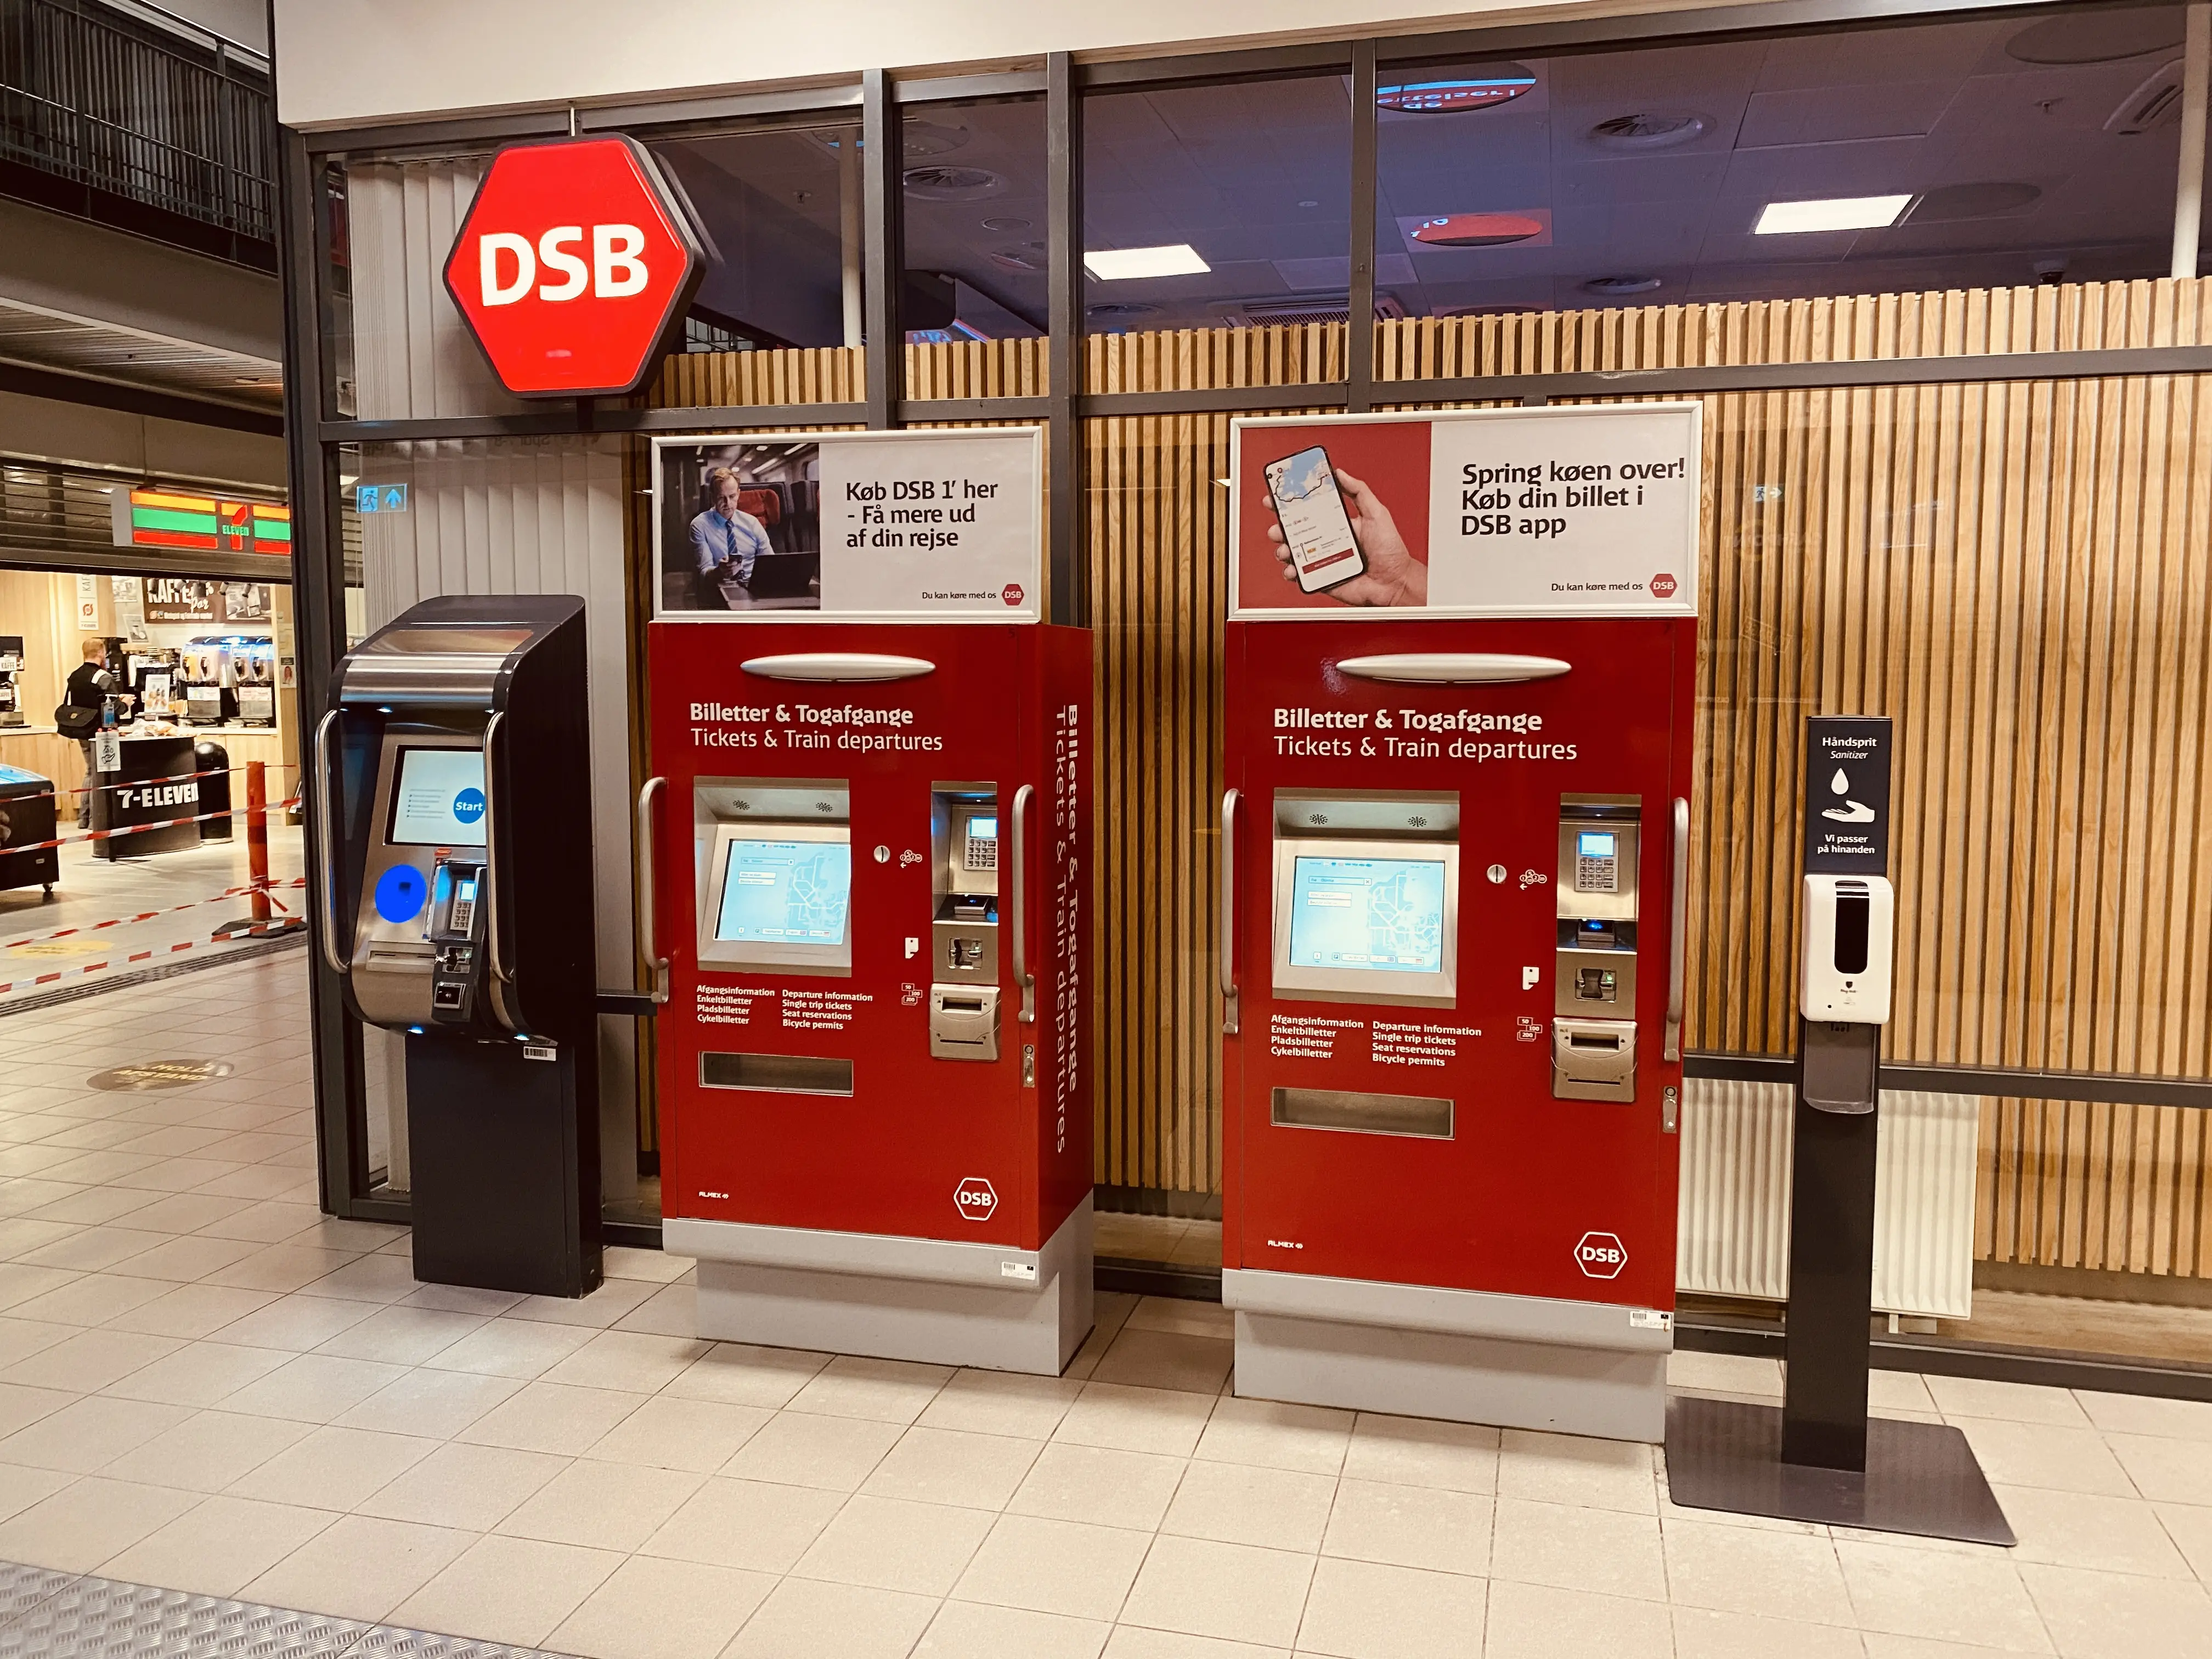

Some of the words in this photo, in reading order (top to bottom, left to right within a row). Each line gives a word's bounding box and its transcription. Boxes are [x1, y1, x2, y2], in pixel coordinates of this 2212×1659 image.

[479, 224, 648, 307] DSB
[1463, 463, 1542, 487] Spring
[1550, 461, 1611, 481] køen
[1620, 458, 1684, 479] over!
[847, 482, 886, 501] Køb
[894, 481, 934, 500] DSB
[964, 479, 998, 498] her
[1463, 488, 1510, 510] Køb
[1519, 488, 1556, 508] din
[1566, 486, 1628, 507] billet
[1638, 485, 1643, 505] i
[863, 504, 884, 524] Få
[891, 509, 943, 523] mere
[950, 503, 975, 522] ud
[1462, 515, 1511, 535] DSB
[1519, 518, 1566, 539] app
[847, 528, 867, 547] af
[872, 528, 902, 547] din
[910, 528, 958, 551] rejse
[82, 574, 92, 591] KAF
[691, 703, 770, 721] Billetter
[776, 704, 791, 722] &
[795, 705, 913, 727] Togafgange
[1274, 708, 1368, 728] Billetter
[1375, 709, 1392, 729] &
[1399, 709, 1542, 734] Togafgange
[691, 729, 757, 747] Tickets
[764, 730, 777, 747] &
[784, 730, 830, 748] Train
[838, 730, 942, 753] departures
[1822, 736, 1877, 748] Håndsprit
[1274, 736, 1351, 755] Tickets
[1360, 737, 1375, 756] &
[1384, 737, 1439, 757] Train
[1449, 738, 1577, 763] departures
[1830, 751, 1868, 759] Sanitizer
[1056, 704, 1066, 827] Tickets
[1069, 704, 1077, 845] Billetter
[455, 802, 483, 811] Start
[1057, 840, 1066, 864] &
[1817, 845, 1829, 854] på
[1831, 845, 1875, 854] hinanden
[1069, 856, 1077, 883] &
[1057, 874, 1066, 958] Train
[697, 984, 775, 997] Afgangsinformation
[782, 990, 823, 1000] Departure
[825, 991, 873, 1001] information
[1068, 889, 1078, 1092] Togafgange
[697, 995, 753, 1005] Enkeltbilletter
[782, 1000, 807, 1010] Single
[809, 1001, 823, 1011] trip
[825, 1001, 853, 1011] tickets
[697, 1005, 750, 1015] Pladsbilletter
[782, 1009, 800, 1018] Seat
[802, 1011, 852, 1020] reservations
[697, 1014, 750, 1025] Cykelbilletter
[782, 1019, 811, 1029] Bicycle
[812, 1022, 844, 1030] permits
[1271, 1014, 1364, 1029] Afgangsinformation
[1271, 1025, 1337, 1037] Enkeltbilletter
[1373, 1021, 1421, 1033] Departure
[1424, 1024, 1482, 1036] information
[1271, 1036, 1333, 1048] Pladsbilletter
[1372, 1032, 1402, 1043] Single
[1404, 1034, 1421, 1045] trip
[1424, 1035, 1457, 1046] tickets
[1271, 1046, 1333, 1059] Cykelbilletter
[1372, 1043, 1393, 1053] Seat
[1396, 1045, 1456, 1056] reservations
[1056, 971, 1066, 1153] departures
[1372, 1053, 1406, 1065] Bicycle
[1408, 1056, 1445, 1066] permits
[961, 1192, 991, 1206] DSB
[1268, 1240, 1294, 1249] ALMEX
[1583, 1246, 1620, 1263] DSB
